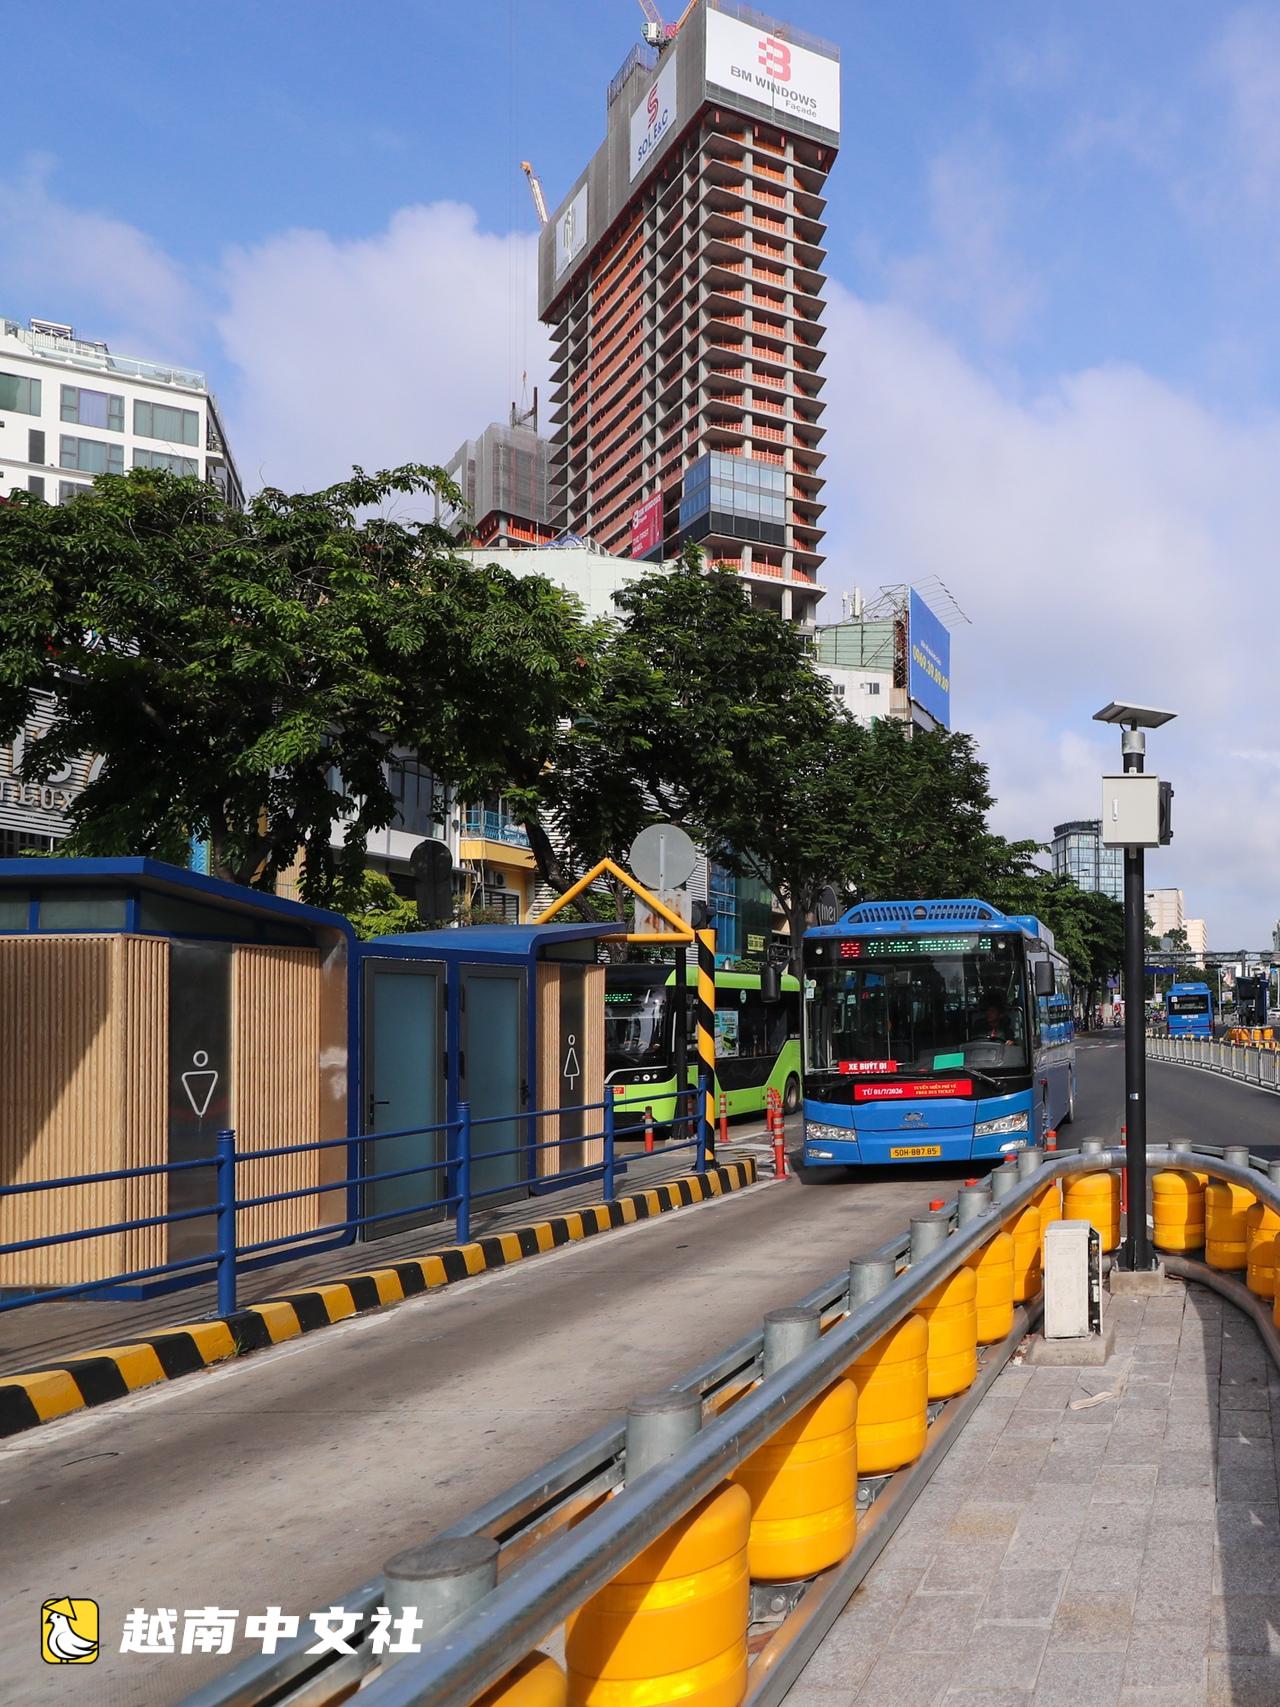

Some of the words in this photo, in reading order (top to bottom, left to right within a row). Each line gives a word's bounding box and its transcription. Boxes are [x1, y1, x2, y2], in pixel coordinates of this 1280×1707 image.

[730, 65, 752, 82] BM
[755, 76, 817, 109] WINDOWS
[785, 100, 817, 118] Façade
[638, 131, 653, 161] SOL
